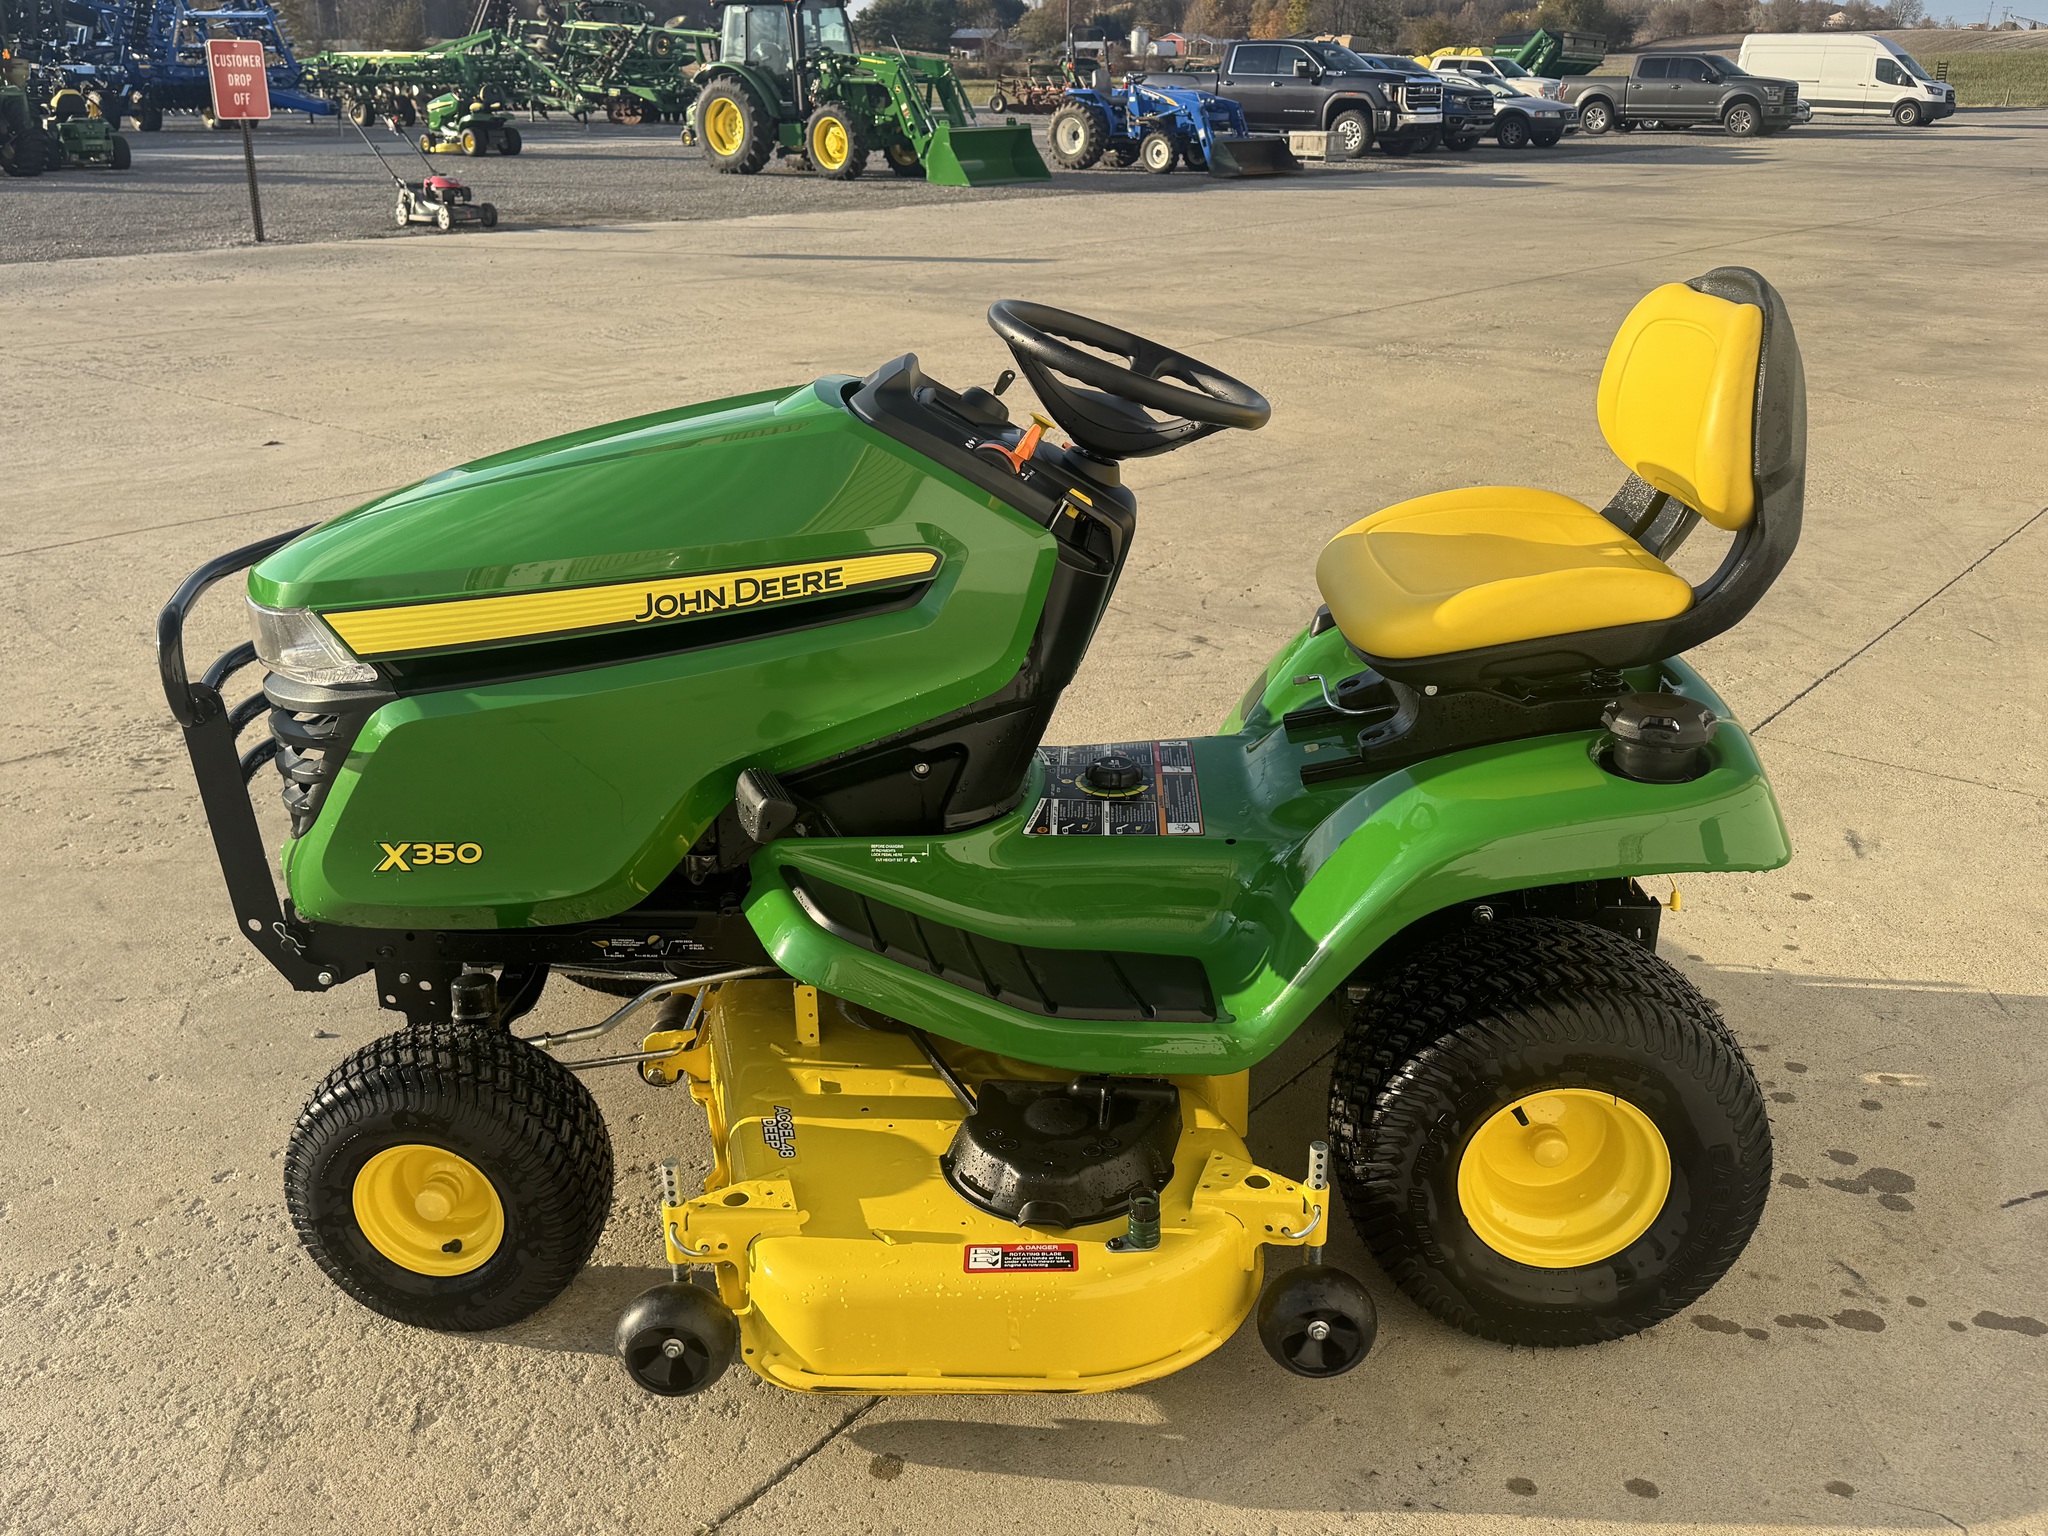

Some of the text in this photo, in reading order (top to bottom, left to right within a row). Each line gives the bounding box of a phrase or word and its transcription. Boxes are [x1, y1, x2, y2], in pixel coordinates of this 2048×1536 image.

[213, 54, 261, 67] CUSTOMER
[227, 73, 252, 87] DROP
[233, 92, 250, 106] OFF
[635, 566, 844, 619] JOHN DEERE
[376, 841, 483, 872] X350
[761, 1118, 781, 1150] DEEP
